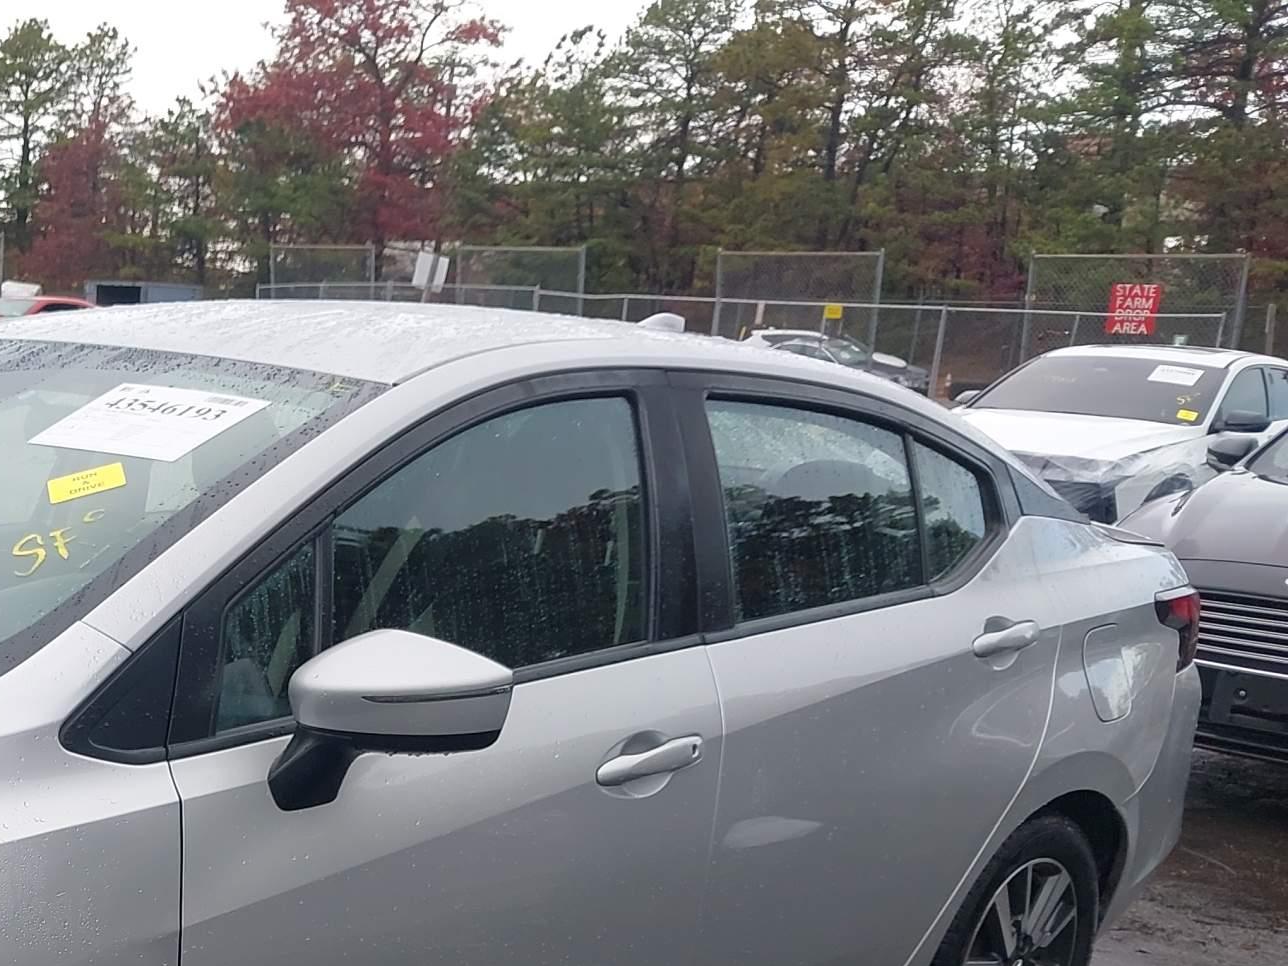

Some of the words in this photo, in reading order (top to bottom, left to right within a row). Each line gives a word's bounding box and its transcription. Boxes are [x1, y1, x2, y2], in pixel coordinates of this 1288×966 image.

[1115, 283, 1158, 297] STATE
[1115, 296, 1154, 309] FARM
[1114, 308, 1151, 321] DROP
[1111, 322, 1148, 335] AREA
[104, 397, 227, 421] 43546193
[68, 481, 106, 495] DRIVE
